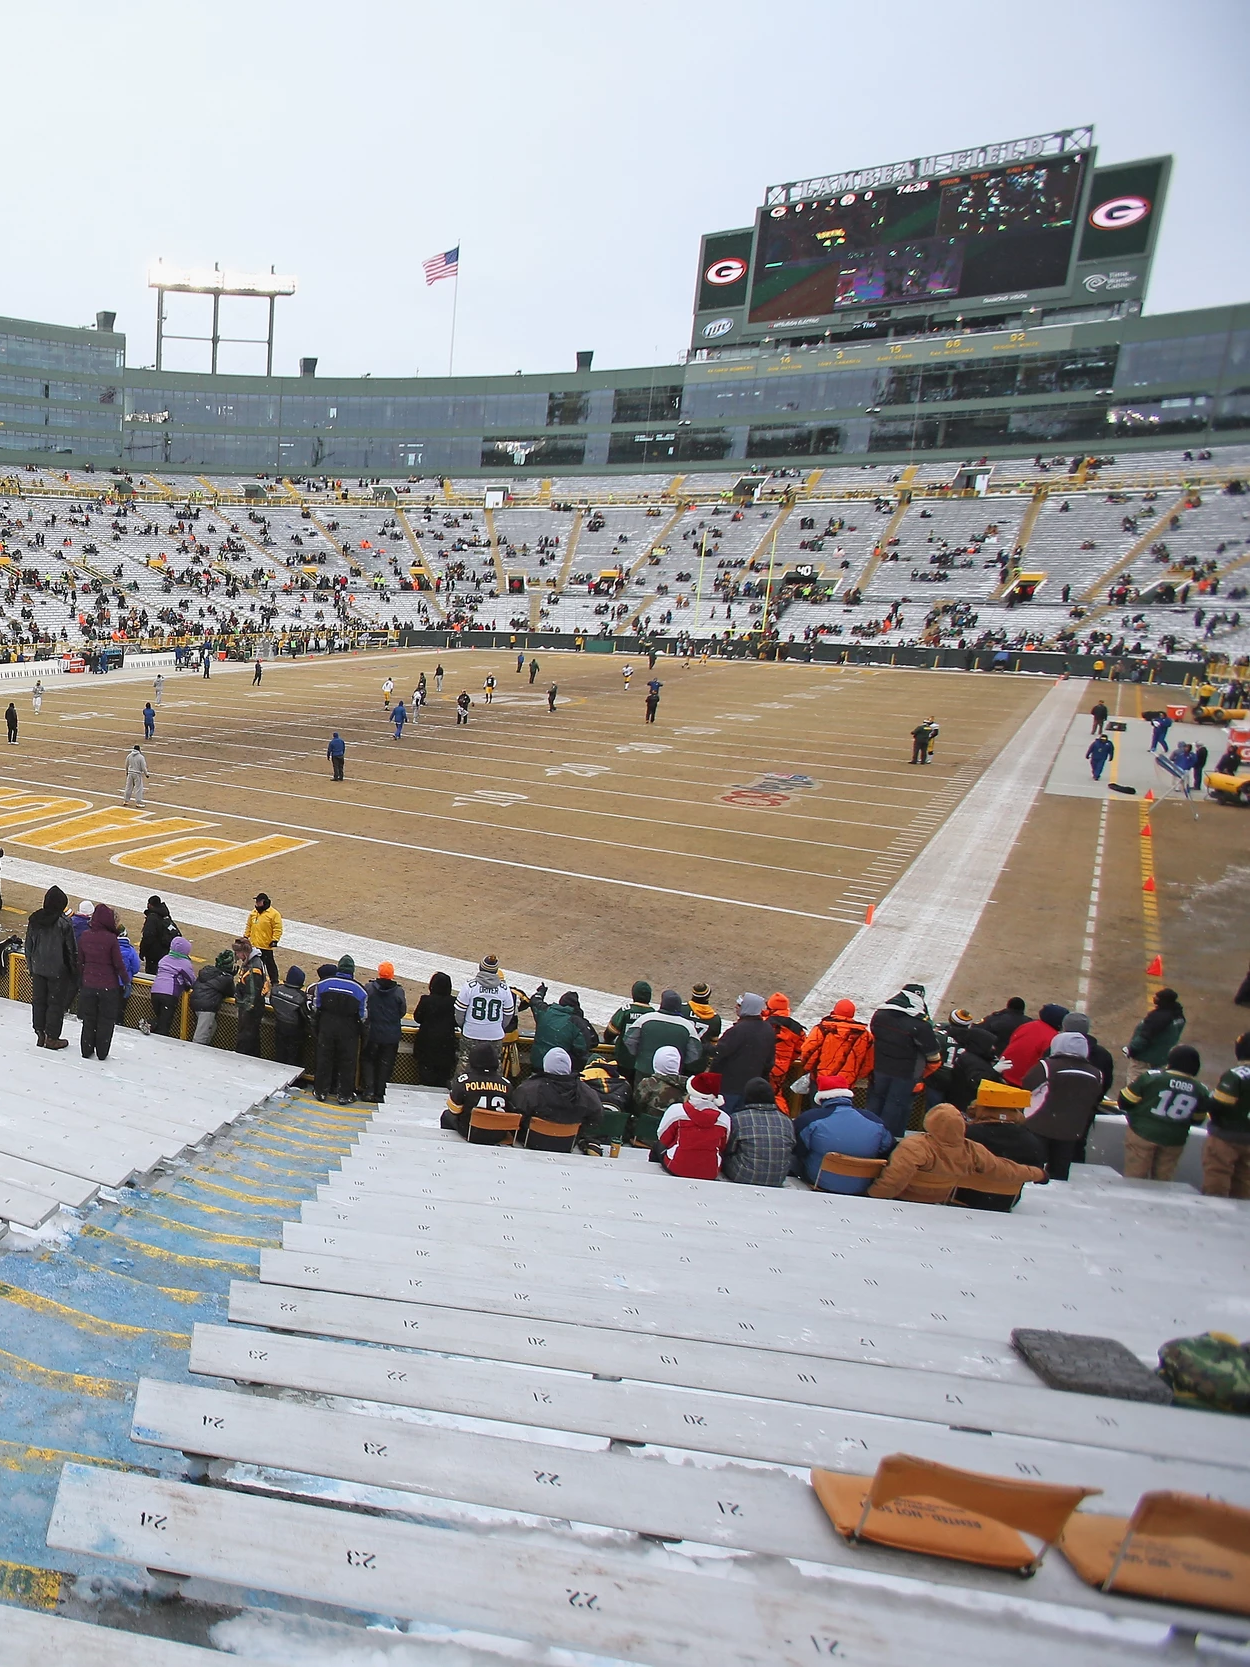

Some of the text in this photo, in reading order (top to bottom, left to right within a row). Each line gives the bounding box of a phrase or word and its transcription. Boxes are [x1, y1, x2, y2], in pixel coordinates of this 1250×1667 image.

[800, 137, 1044, 198] LAMBEAU FIELD
[896, 181, 929, 196] 74:35
[1091, 196, 1149, 230] G
[705, 257, 747, 286] G
[1109, 271, 1131, 279] Time
[1105, 283, 1131, 291] Cable
[1009, 333, 1026, 342] 92
[836, 350, 844, 360] 3
[890, 344, 902, 354] 15
[796, 565, 812, 577] 40
[472, 997, 502, 1022] 80
[465, 1081, 507, 1093] POLAMALU
[1169, 1078, 1194, 1092] COBB
[1150, 1089, 1198, 1120] 18
[528, 1338, 546, 1346] 20
[249, 1350, 268, 1361] 23
[660, 1356, 678, 1365] 19
[387, 1370, 407, 1382] 22
[203, 1415, 224, 1429] 24
[683, 1414, 707, 1426] 20
[364, 1442, 387, 1457] 23
[1015, 1463, 1041, 1475] 18
[534, 1470, 561, 1486] 22
[717, 1501, 743, 1516] 21
[894, 1507, 923, 1520] NOT
[141, 1512, 167, 1530] 24
[931, 1513, 982, 1530] RENTED
[347, 1551, 375, 1569] 23
[566, 1589, 600, 1610] 22
[811, 1635, 845, 1658] 21
